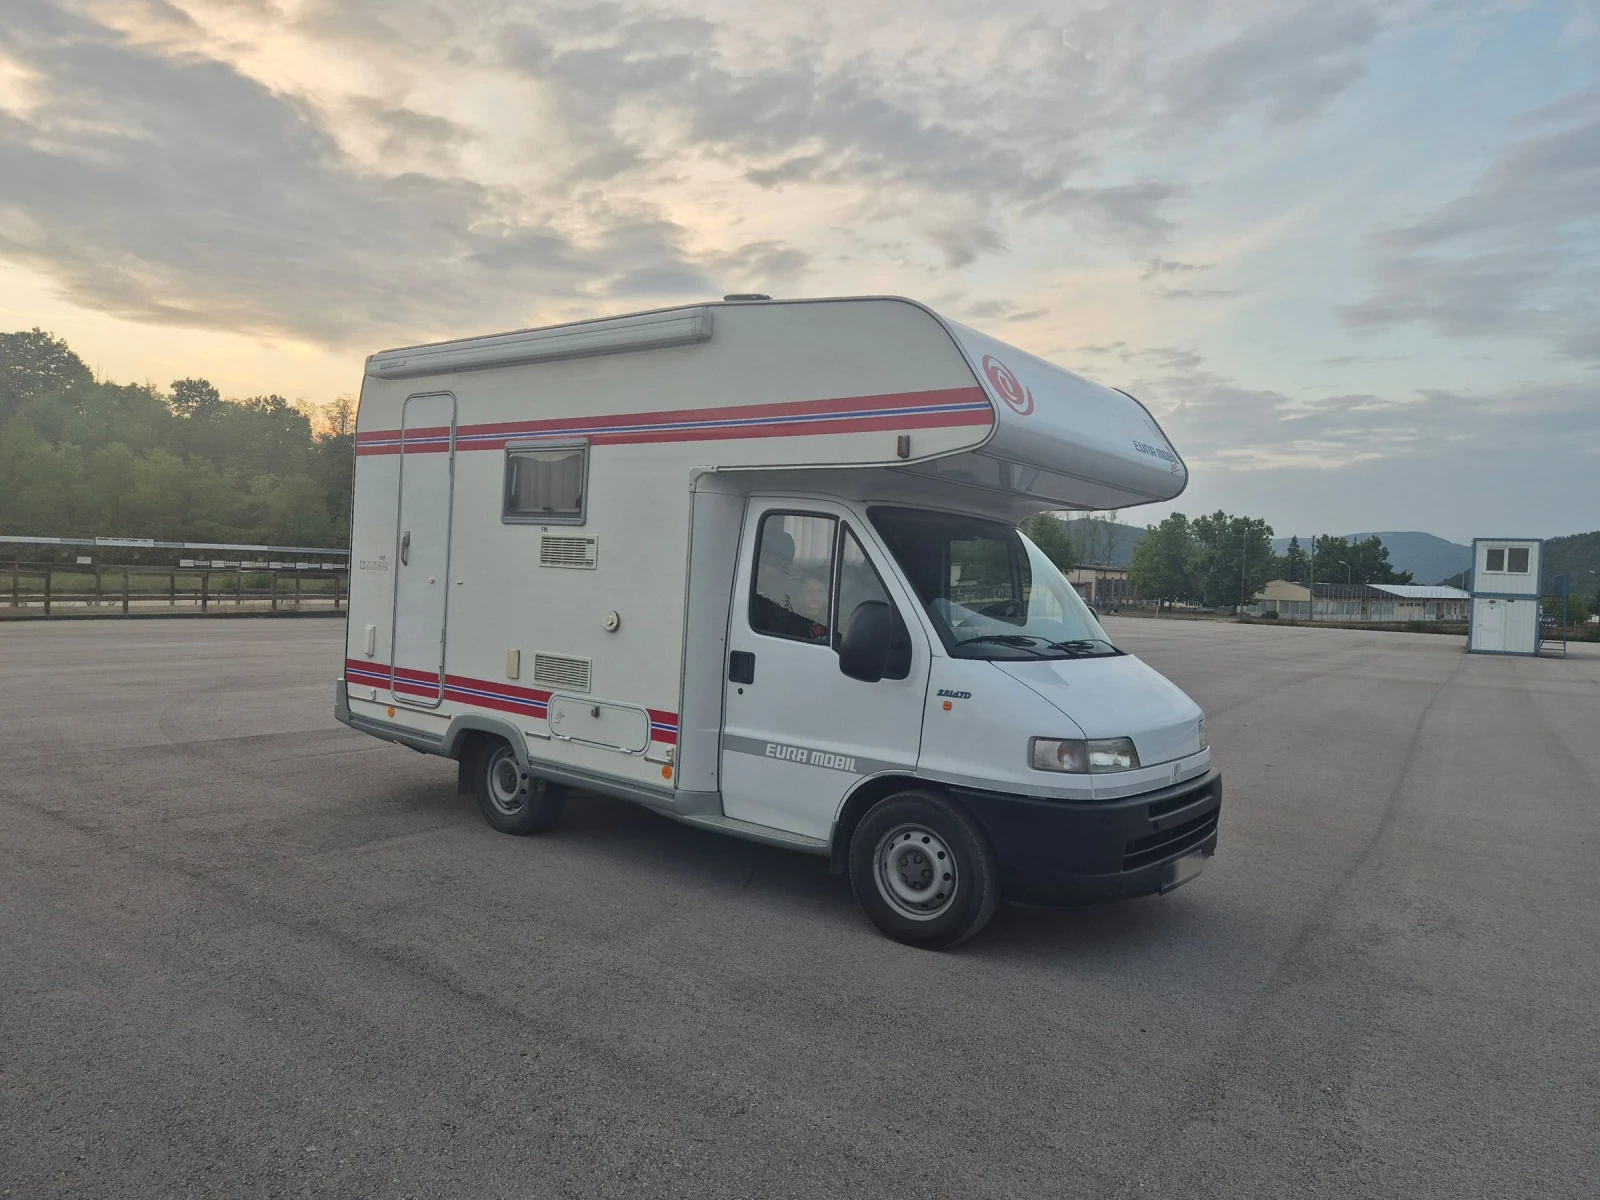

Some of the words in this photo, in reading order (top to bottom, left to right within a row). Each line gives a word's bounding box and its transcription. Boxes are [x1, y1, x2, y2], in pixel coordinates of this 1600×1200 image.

[1132, 440, 1157, 457] EURA
[765, 743, 808, 763] EURA
[810, 751, 857, 772] MOBIL
